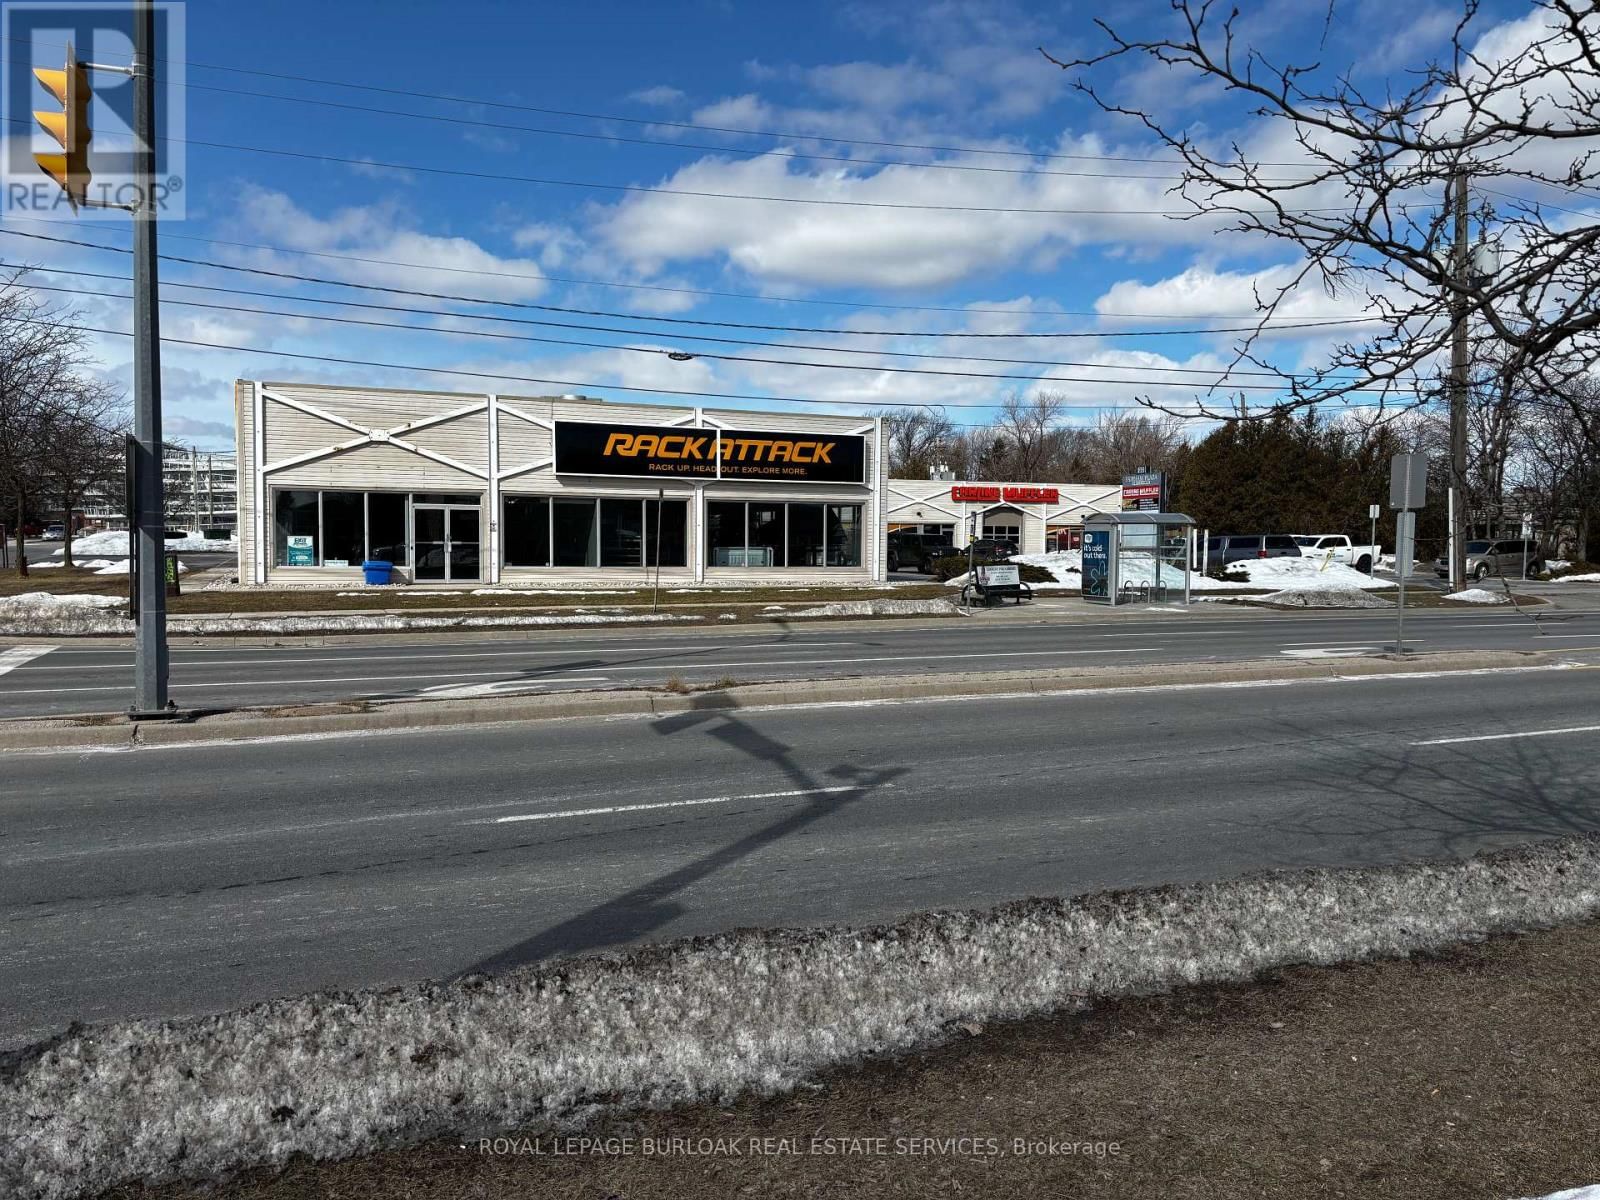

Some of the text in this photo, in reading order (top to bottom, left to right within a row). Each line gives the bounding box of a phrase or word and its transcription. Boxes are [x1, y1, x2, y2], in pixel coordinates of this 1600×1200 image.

[603, 433, 837, 464] RACK ATTACK
[648, 463, 674, 471] RACK
[677, 464, 691, 472] UP.
[693, 465, 717, 473] HEAD
[742, 466, 781, 474] EXPLORE
[782, 467, 808, 475] MORE.
[1003, 487, 1059, 503] MUFFLER
[1083, 544, 1103, 552] it's cold
